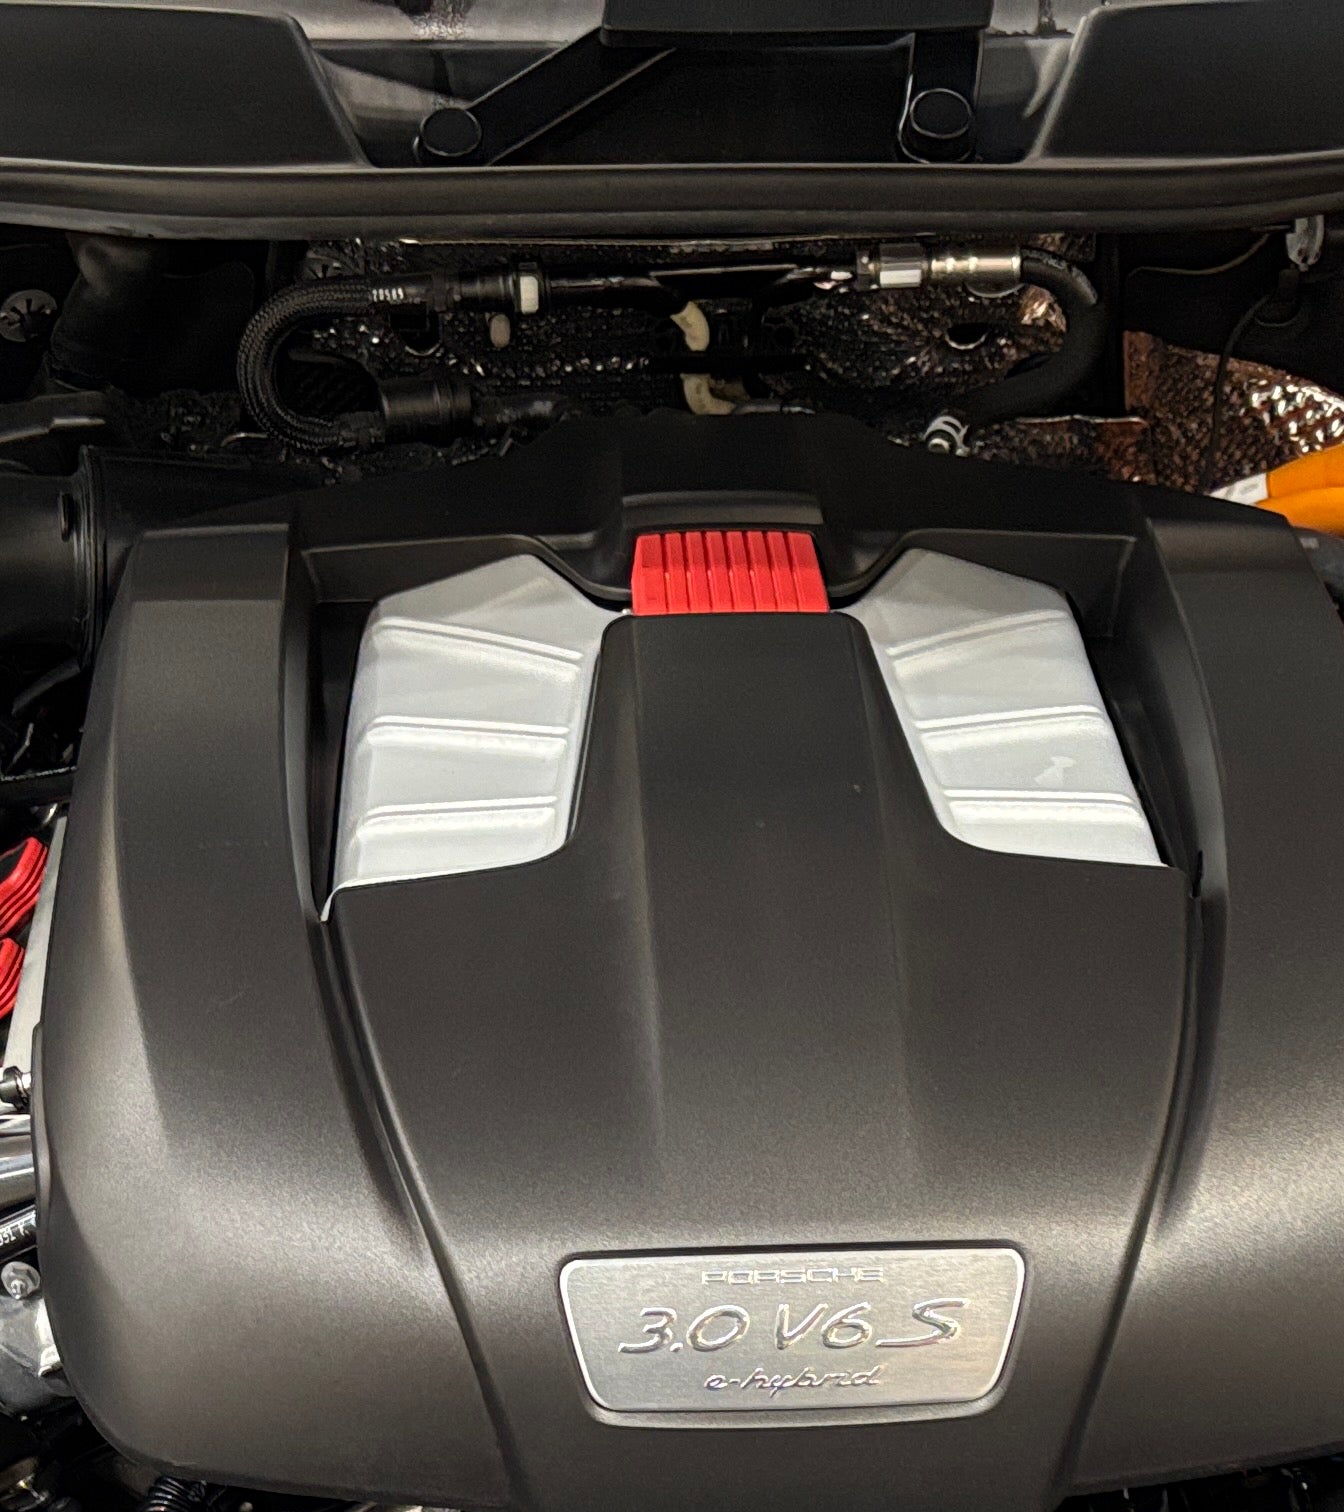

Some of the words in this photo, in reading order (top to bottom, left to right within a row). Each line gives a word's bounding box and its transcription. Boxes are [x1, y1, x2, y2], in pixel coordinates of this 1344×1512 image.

[701, 1266, 885, 1286] PORSCHE
[617, 1305, 751, 1354] 3.0
[774, 1301, 873, 1352] V6
[874, 1297, 969, 1348] S
[703, 1364, 885, 1399] e-hybrid
